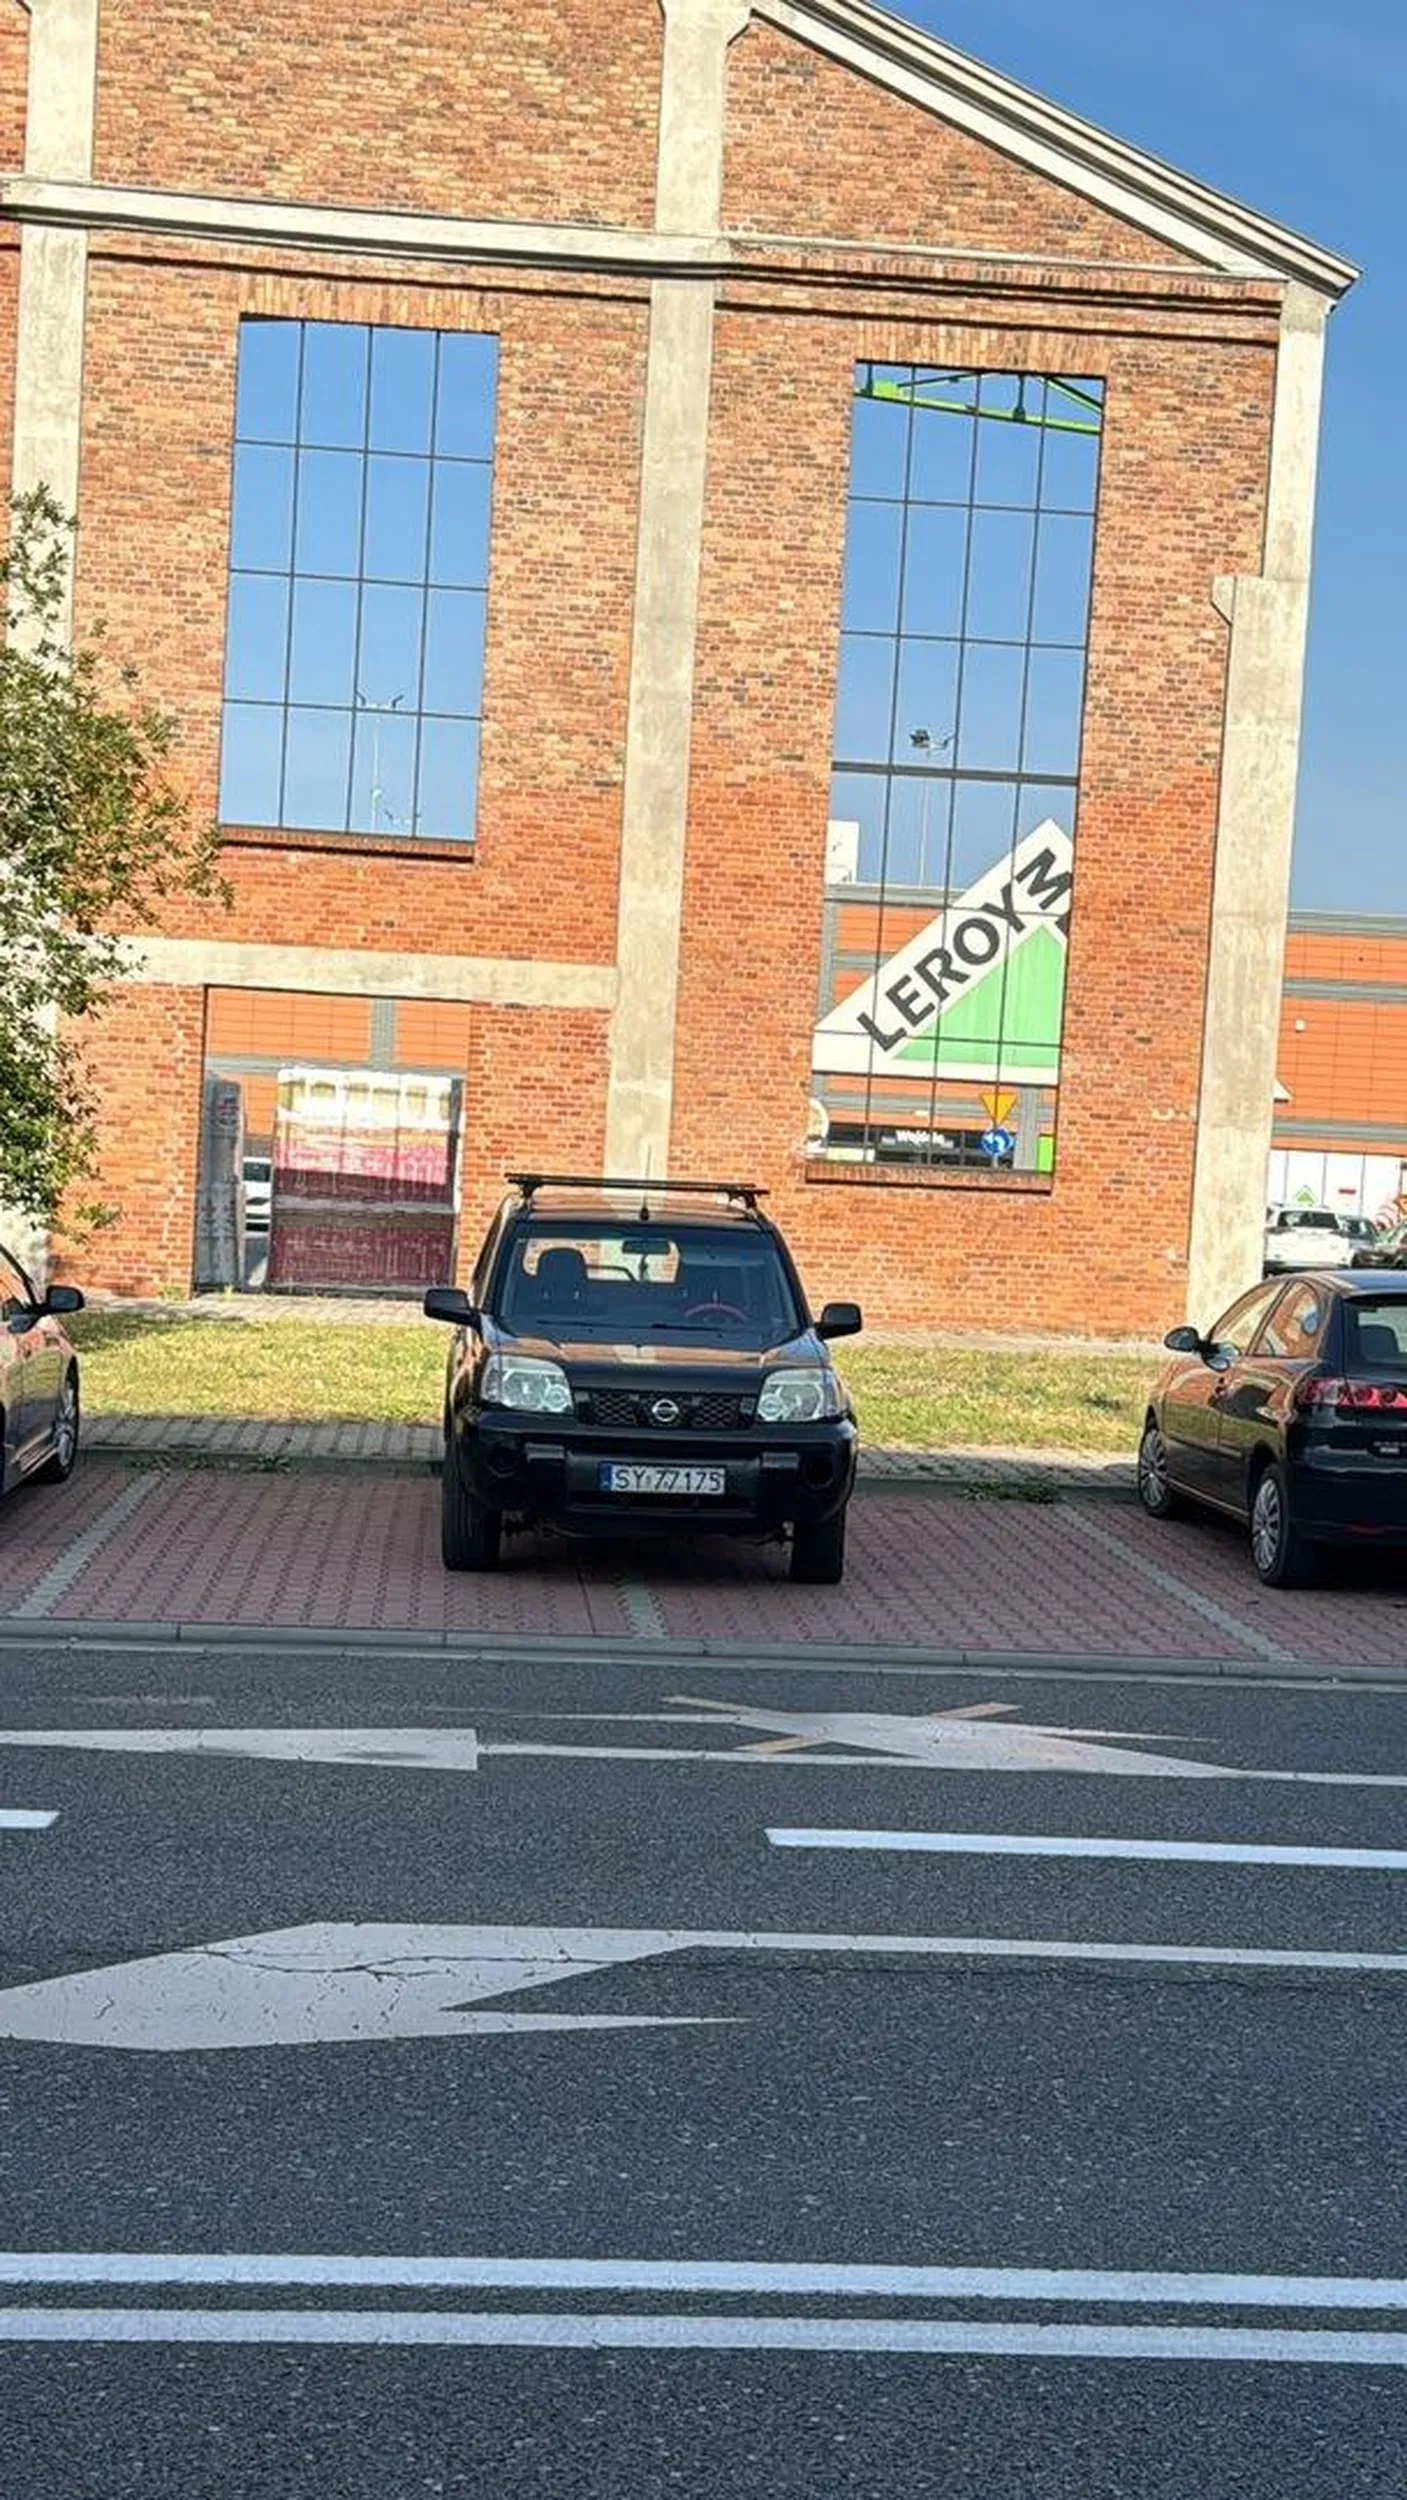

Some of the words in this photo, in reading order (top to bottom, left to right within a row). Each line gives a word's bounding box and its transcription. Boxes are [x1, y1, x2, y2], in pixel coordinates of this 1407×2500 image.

[856, 881, 1026, 1052] LEROY
[1015, 847, 1073, 937] M
[615, 1469, 646, 1489] SY
